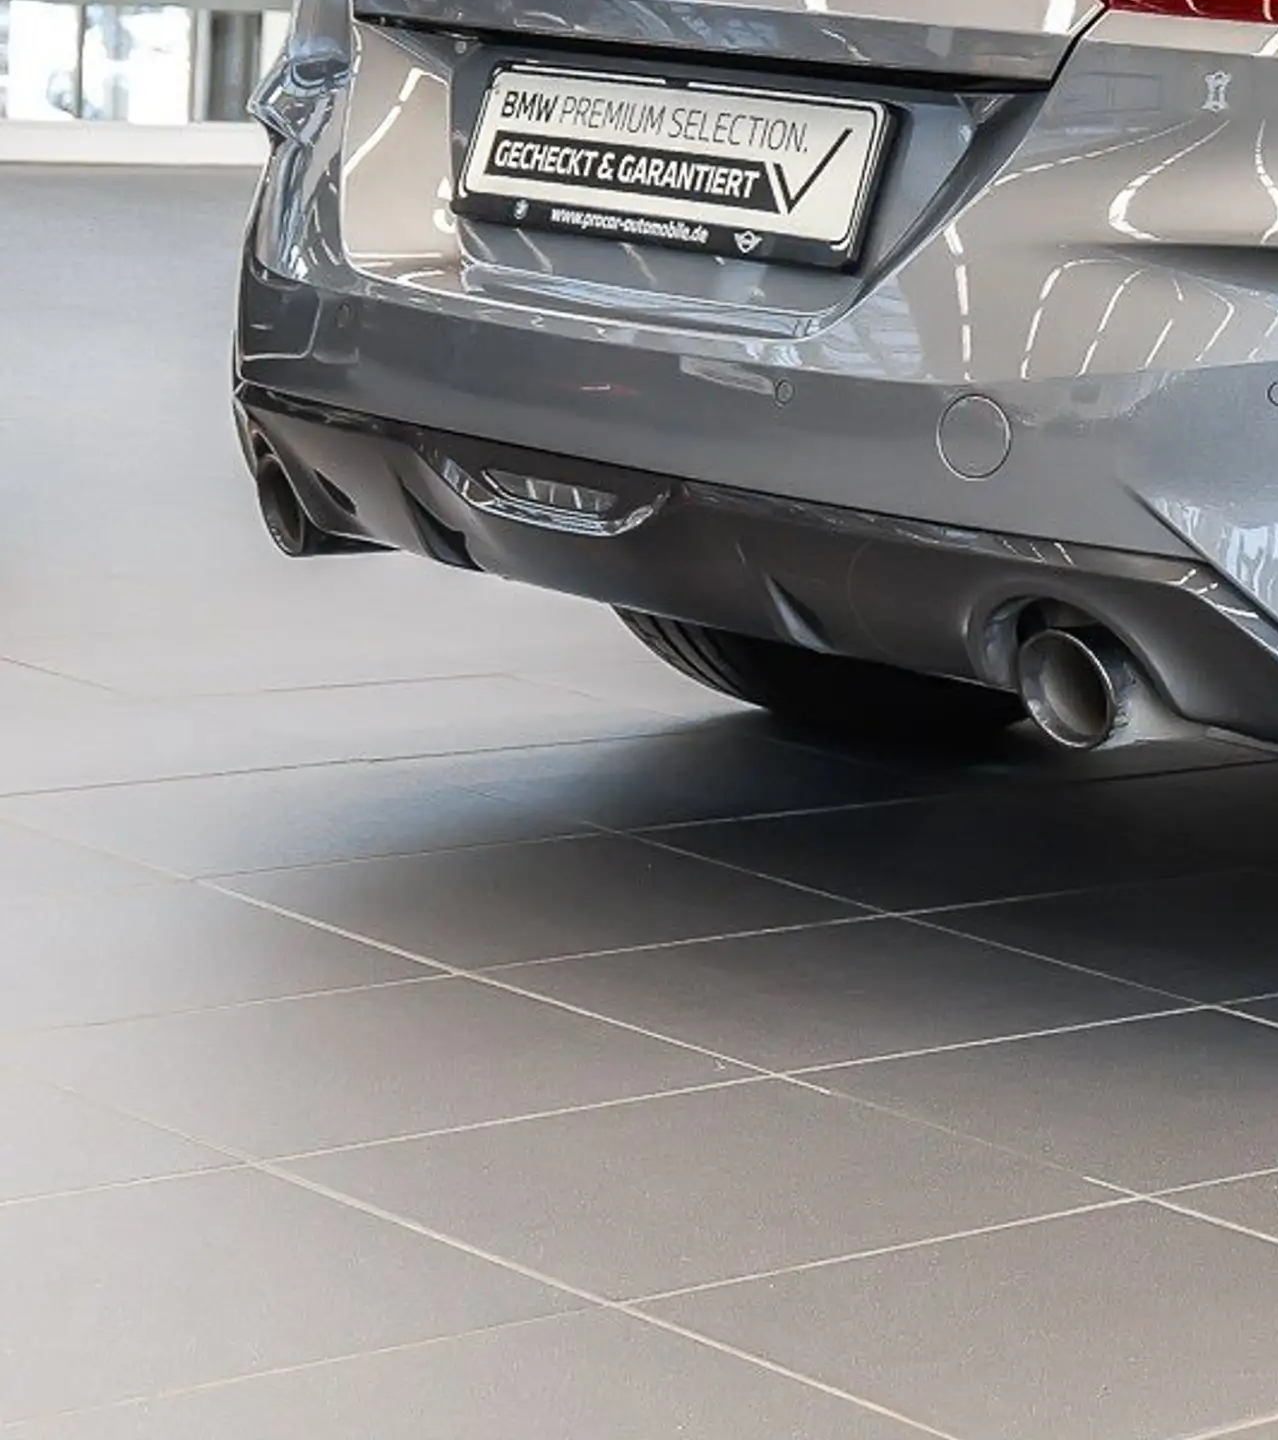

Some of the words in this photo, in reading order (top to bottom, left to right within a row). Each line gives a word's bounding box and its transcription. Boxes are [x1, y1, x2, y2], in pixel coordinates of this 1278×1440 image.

[501, 90, 558, 120] BMW
[560, 95, 666, 137] PREMIUM
[668, 107, 809, 154] SELECTION.
[494, 139, 594, 177] GECHECKT
[597, 155, 614, 181] &
[617, 157, 760, 199] GARANTIERT
[550, 207, 709, 245] www.procar-automobile.de
